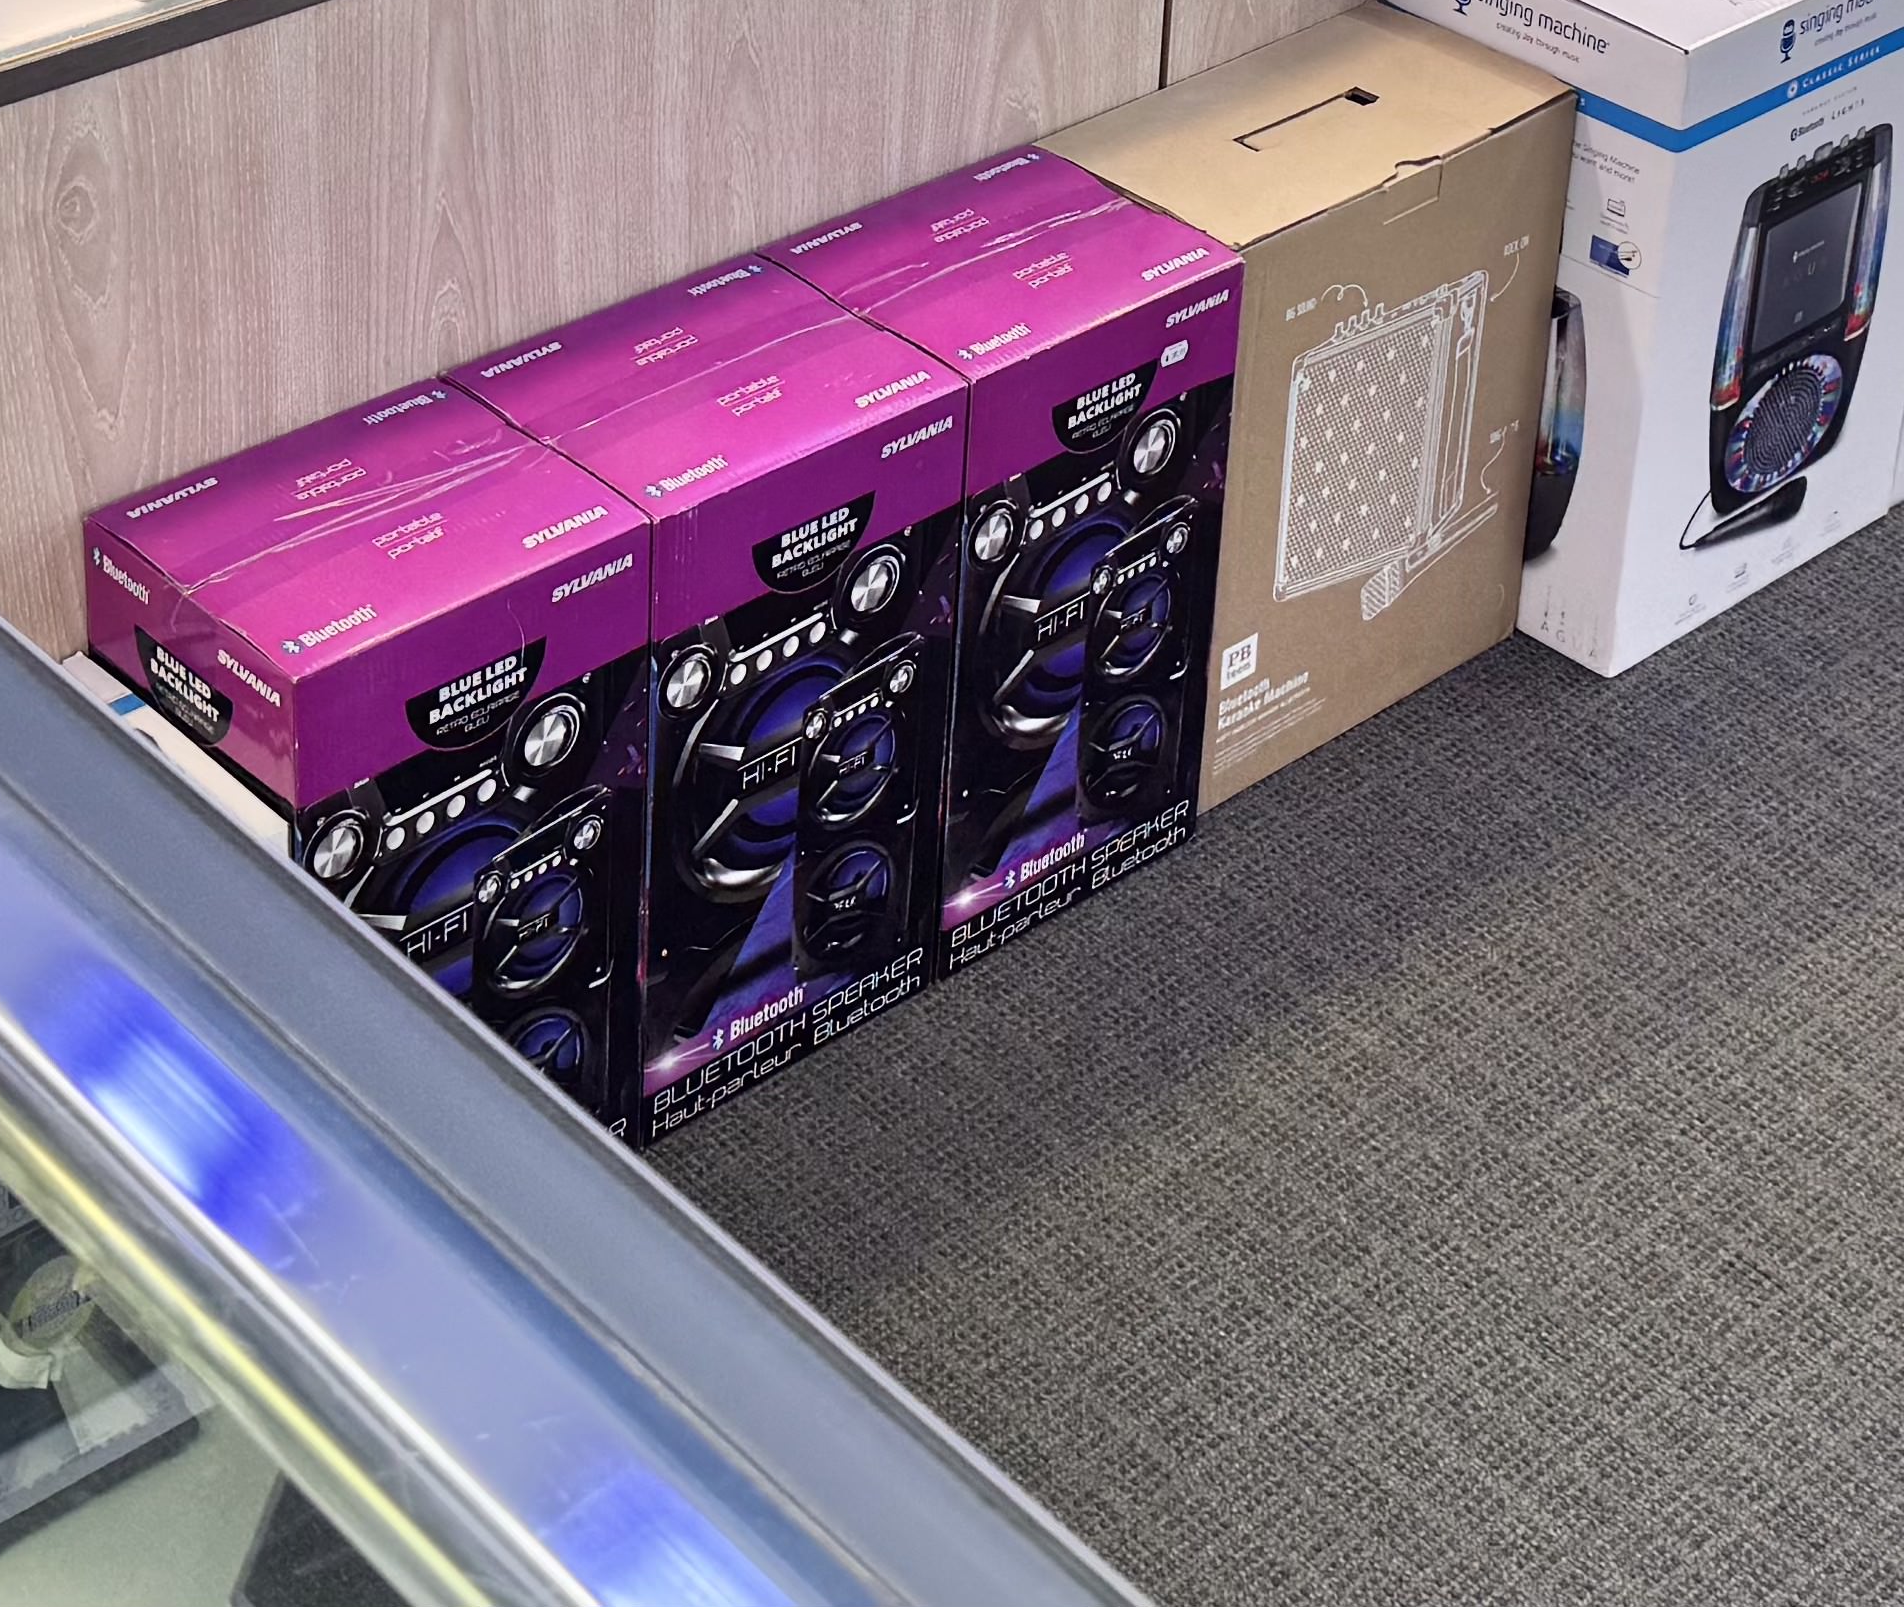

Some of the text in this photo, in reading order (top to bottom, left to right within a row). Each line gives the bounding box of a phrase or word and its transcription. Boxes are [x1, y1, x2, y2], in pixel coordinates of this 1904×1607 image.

[1538, 12, 1610, 54] machine
[1798, 3, 1844, 35] singing
[789, 220, 864, 255] SYLVANIA
[1139, 246, 1210, 284] SYLVANIA
[1164, 288, 1231, 330] SYLVANIA
[480, 340, 564, 379] SYLVANIA
[969, 321, 1033, 359] Bluetooth
[853, 368, 932, 409] SYLVANIA
[1065, 382, 1144, 431] BACKLIGHT
[1075, 371, 1137, 412] BLUE LED
[879, 414, 955, 460] SYLVANIA
[659, 453, 729, 494] Bluetooth
[126, 476, 219, 520] SYLVANIA
[521, 504, 609, 550] SYLVANIA
[770, 518, 858, 569] BACKLIGHT
[778, 506, 851, 550] BLUE LED
[102, 554, 150, 605] Bluetooth
[549, 552, 635, 603] SYLVANIA
[299, 603, 379, 650] Bluetooth
[1036, 597, 1085, 643] HI-FI
[155, 645, 212, 700] BLUE LED
[216, 648, 282, 708] SYLVANIA
[437, 655, 518, 704] BLUE LED
[1227, 644, 1253, 670] PB
[149, 656, 221, 724] BACKLIGHT
[428, 666, 528, 725] BACKLIGHT
[740, 744, 799, 791] HI-FI
[950, 799, 1190, 949] BLUETOOTH SPEAKER
[1019, 828, 1088, 882] Bluetooth
[948, 826, 1188, 971] Haut-parleur Bluetooth
[407, 910, 469, 960] HI-FI
[651, 946, 925, 1118] BLUETOOTH SPEAKER
[729, 985, 808, 1042] Bluetooth
[649, 974, 923, 1140] Haut-parleur Bluetooth
